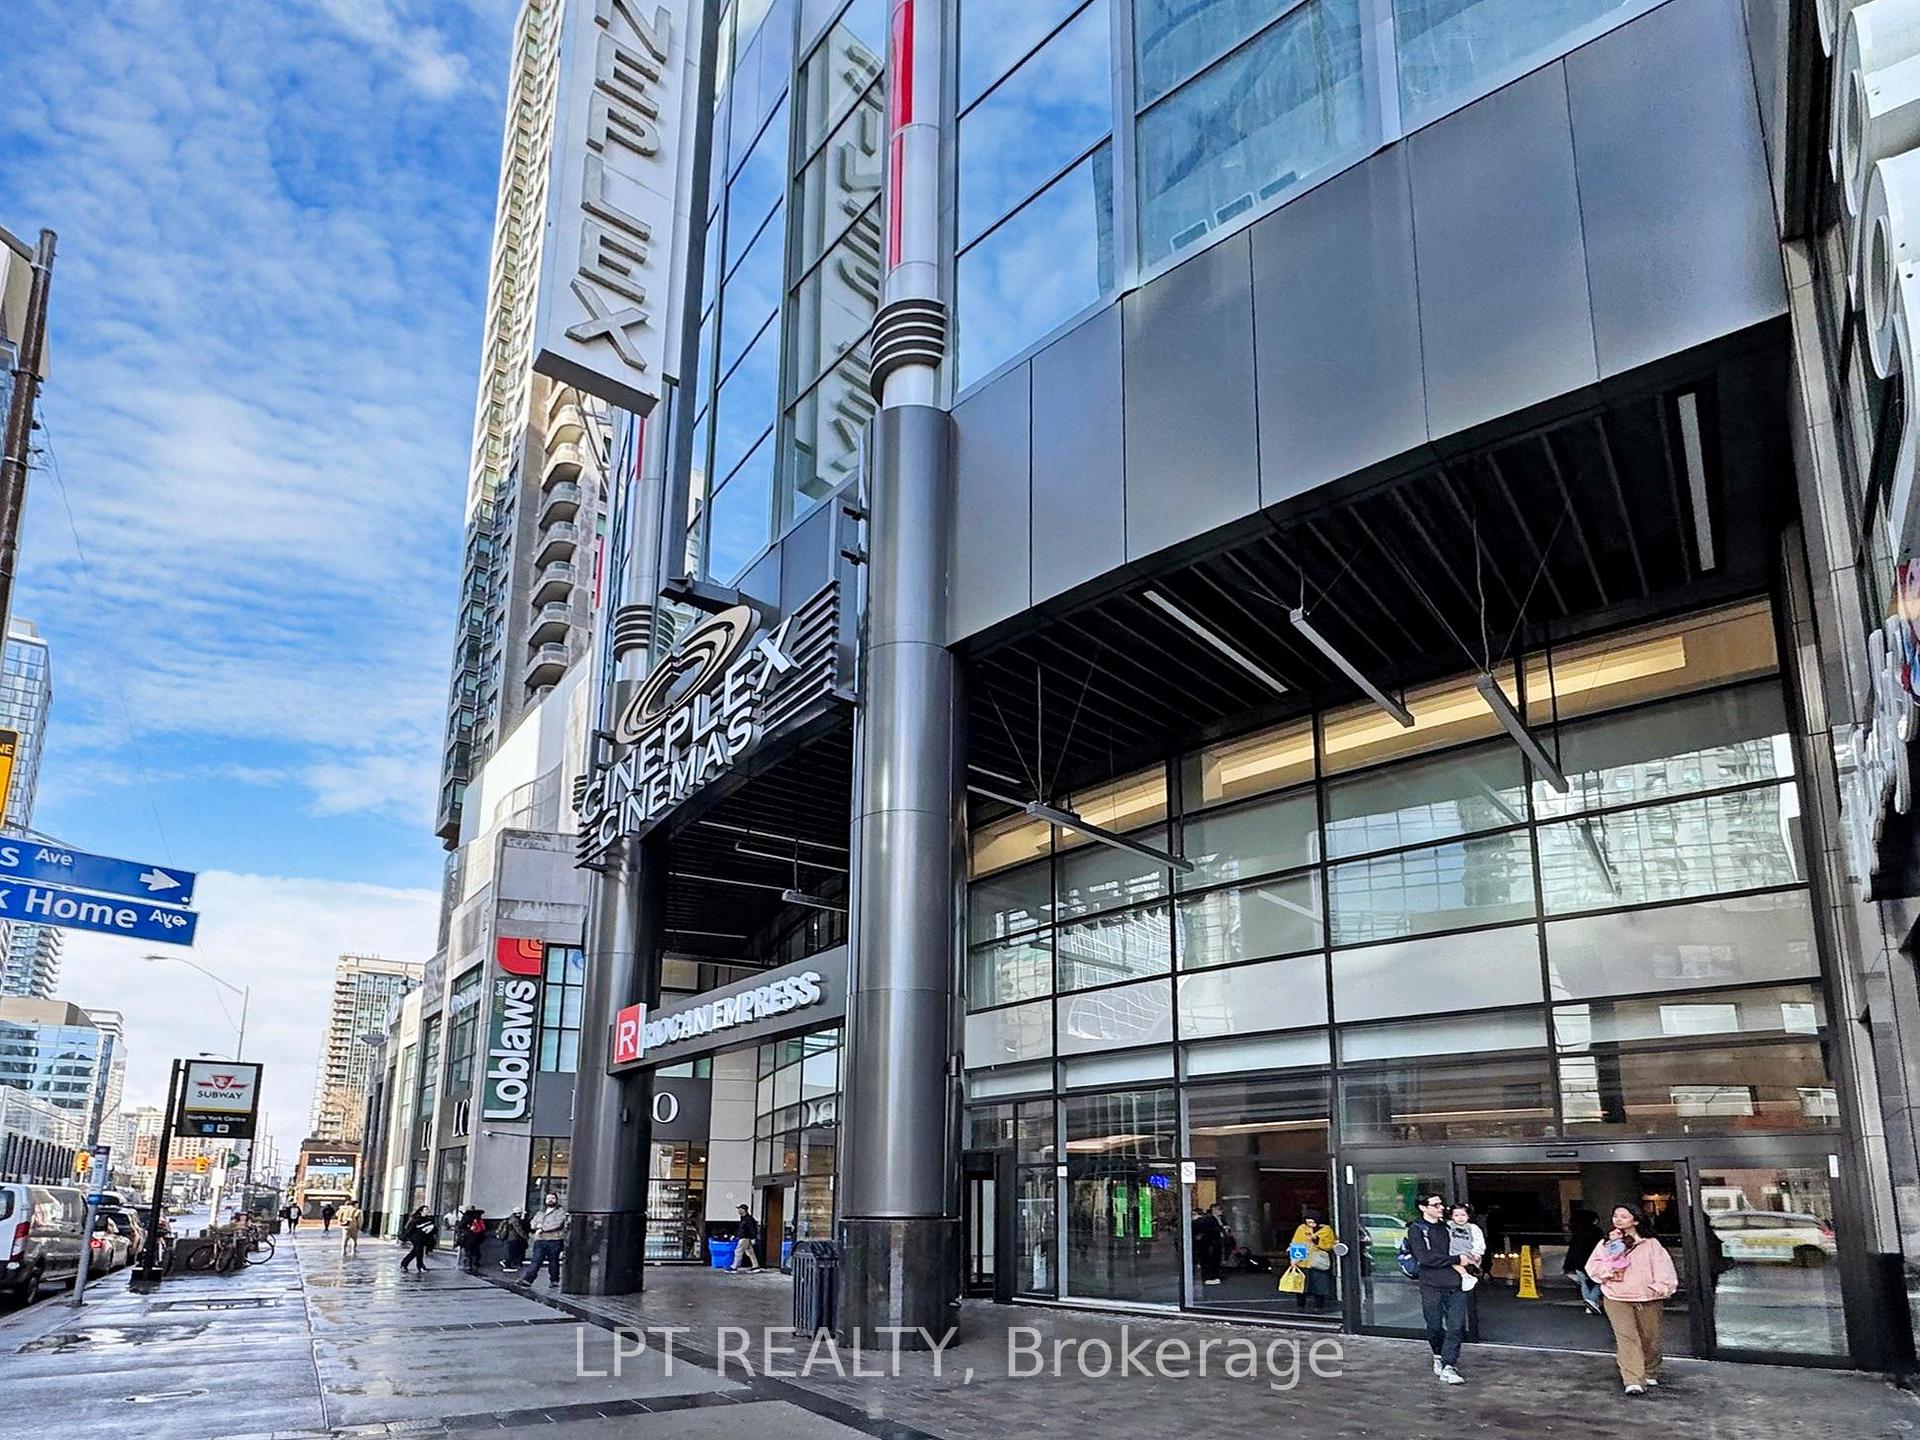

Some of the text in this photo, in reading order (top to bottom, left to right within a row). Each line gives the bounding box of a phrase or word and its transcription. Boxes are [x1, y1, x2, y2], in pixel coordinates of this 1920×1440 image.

[580, 613, 799, 825] CINEPLEX
[598, 705, 757, 846] CINEMAS
[35, 848, 73, 866] Ave
[25, 888, 138, 929] Home
[149, 909, 188, 929] Ave
[711, 970, 821, 1030] EMPRESS
[483, 979, 537, 1120] Loblaws
[617, 1020, 636, 1057] R
[197, 1090, 243, 1100] SUBWAY
